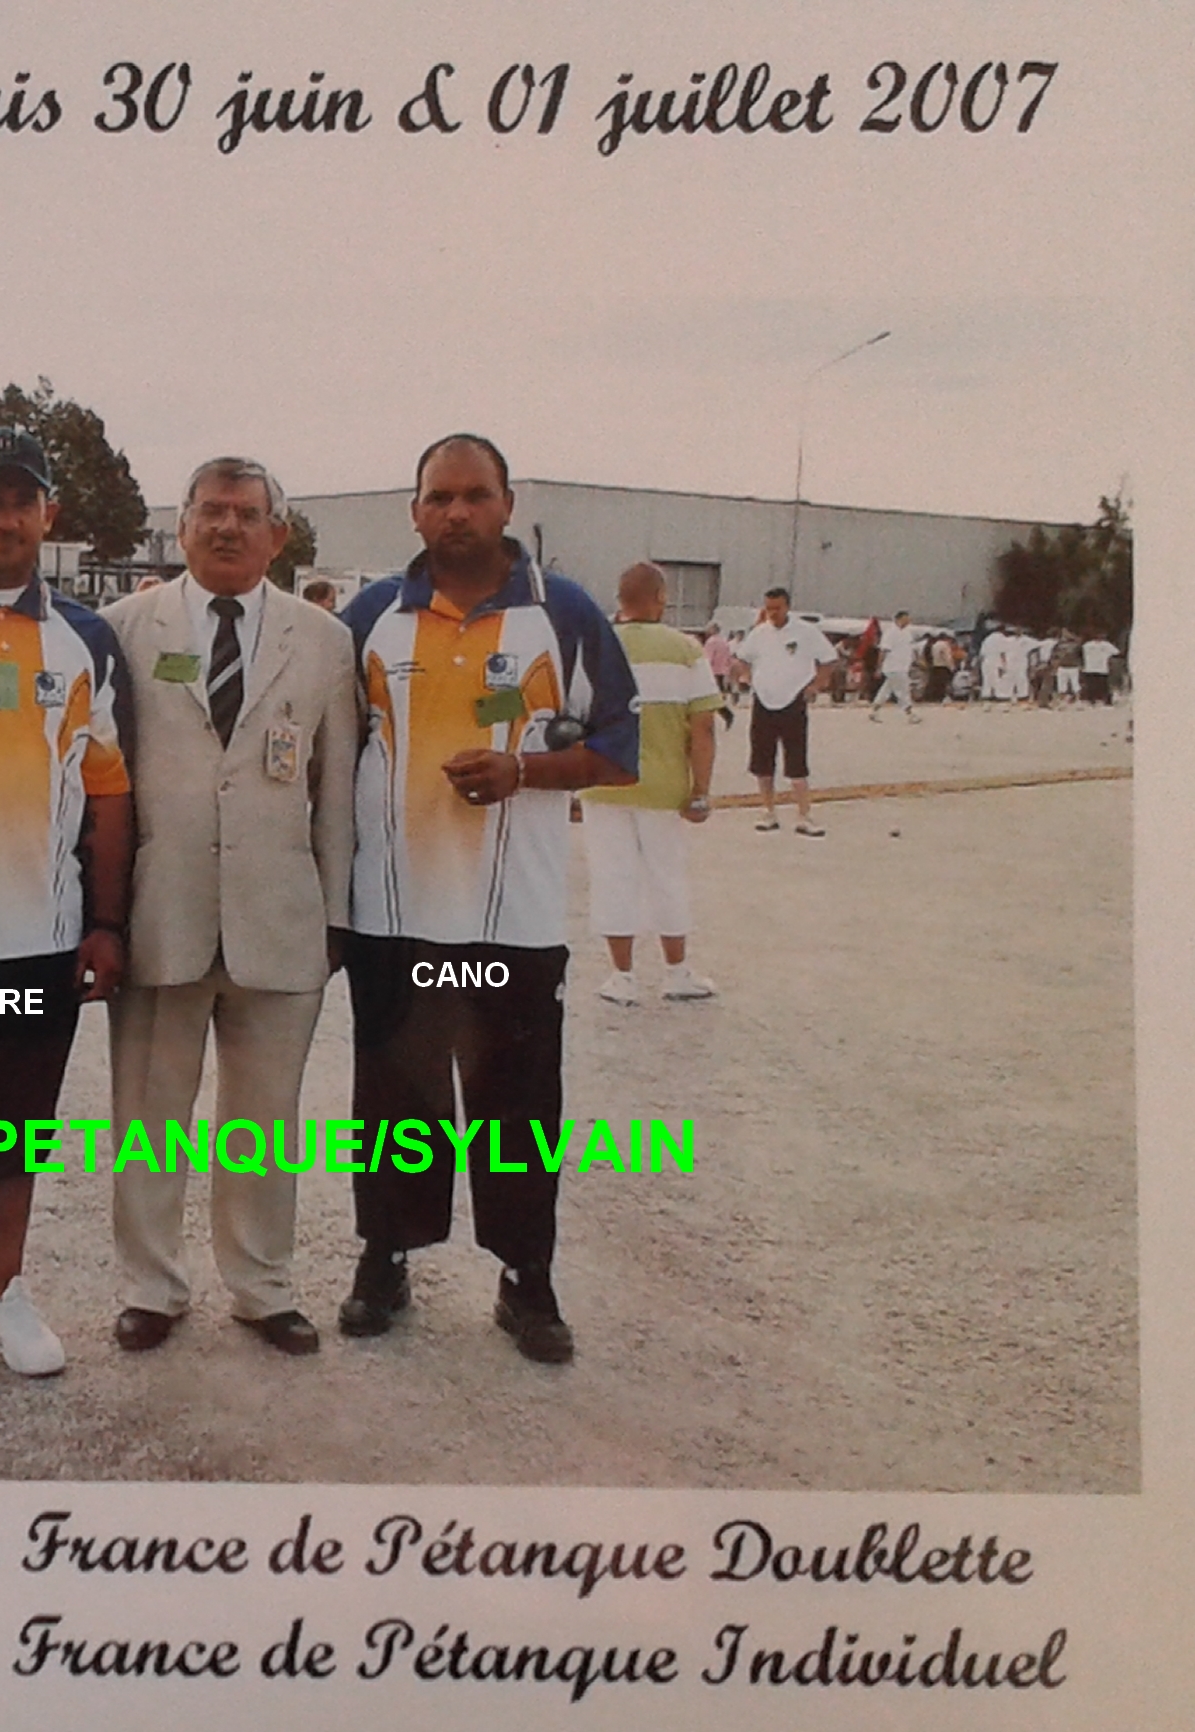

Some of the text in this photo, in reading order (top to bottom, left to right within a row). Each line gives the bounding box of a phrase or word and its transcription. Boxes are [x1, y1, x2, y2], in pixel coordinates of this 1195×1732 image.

[94, 62, 192, 134] 30
[216, 70, 372, 154] juin
[398, 62, 463, 134] &
[487, 62, 571, 134] 01
[595, 62, 834, 157] juillet
[859, 62, 1060, 134] 2007
[21, 1511, 249, 1574] France
[267, 1514, 344, 1575] de
[365, 1514, 687, 1600] Pétanque
[709, 1519, 1035, 1585] Doublette
[12, 1615, 241, 1677] France
[260, 1617, 338, 1679] de
[356, 1618, 679, 1703] Pétanque
[701, 1623, 1069, 1689] Individuel
